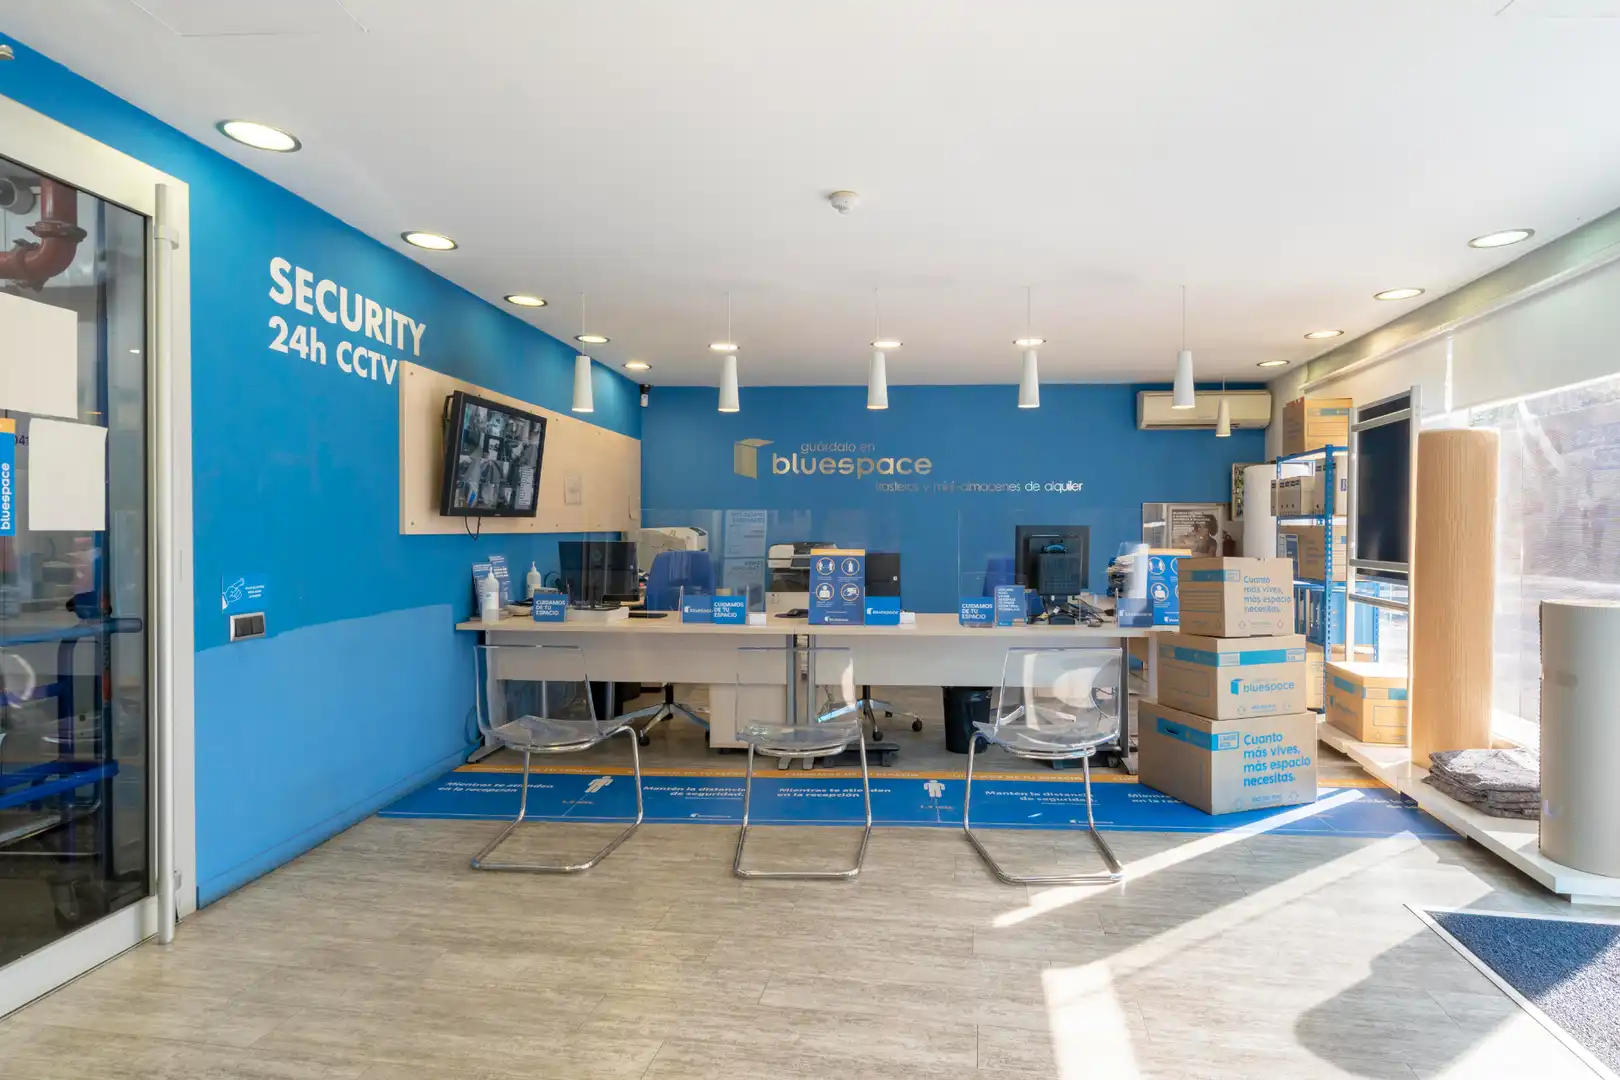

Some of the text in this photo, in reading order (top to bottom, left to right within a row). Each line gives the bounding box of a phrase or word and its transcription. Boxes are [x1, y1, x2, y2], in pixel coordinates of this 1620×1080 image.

[269, 257, 426, 356] SECURITY
[269, 316, 397, 385] 24h CCTV
[772, 453, 933, 479] bluespace
[875, 480, 1083, 493] trasteros y mini-almacenes de alquiler
[1, 463, 12, 530] bluespace
[1243, 575, 1271, 583] Cuanto
[1243, 585, 1261, 593] más
[1244, 595, 1291, 604] más espacio
[1243, 680, 1295, 693] bluespace
[1243, 732, 1283, 746] Cuanto
[1243, 745, 1301, 760] más vives,
[1243, 755, 1311, 773] más espacio
[1243, 772, 1296, 787] necesitas.
